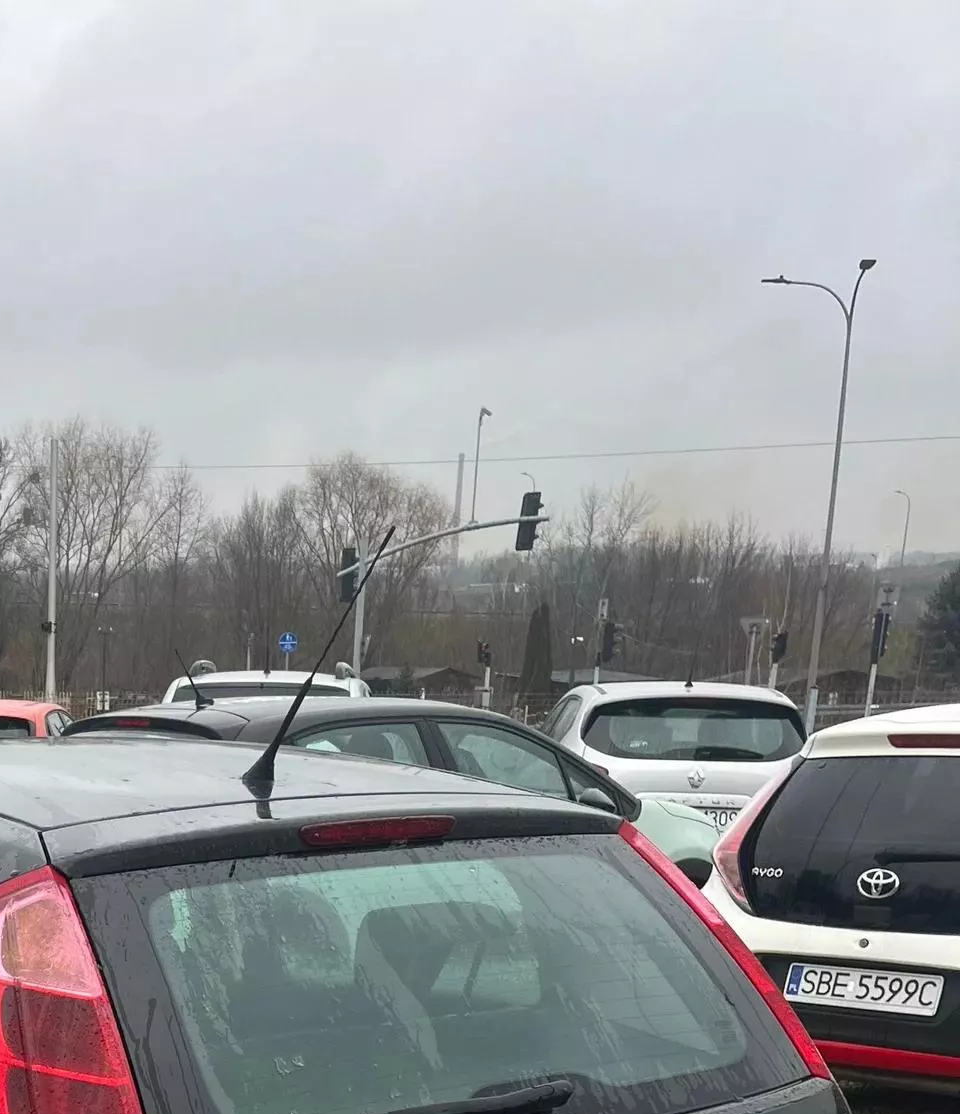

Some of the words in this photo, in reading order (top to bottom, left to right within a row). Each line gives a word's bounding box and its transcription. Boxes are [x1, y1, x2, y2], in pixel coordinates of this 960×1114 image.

[751, 866, 784, 878] AYGO
[802, 969, 850, 998] SBE
[855, 974, 937, 1007] 5599C
